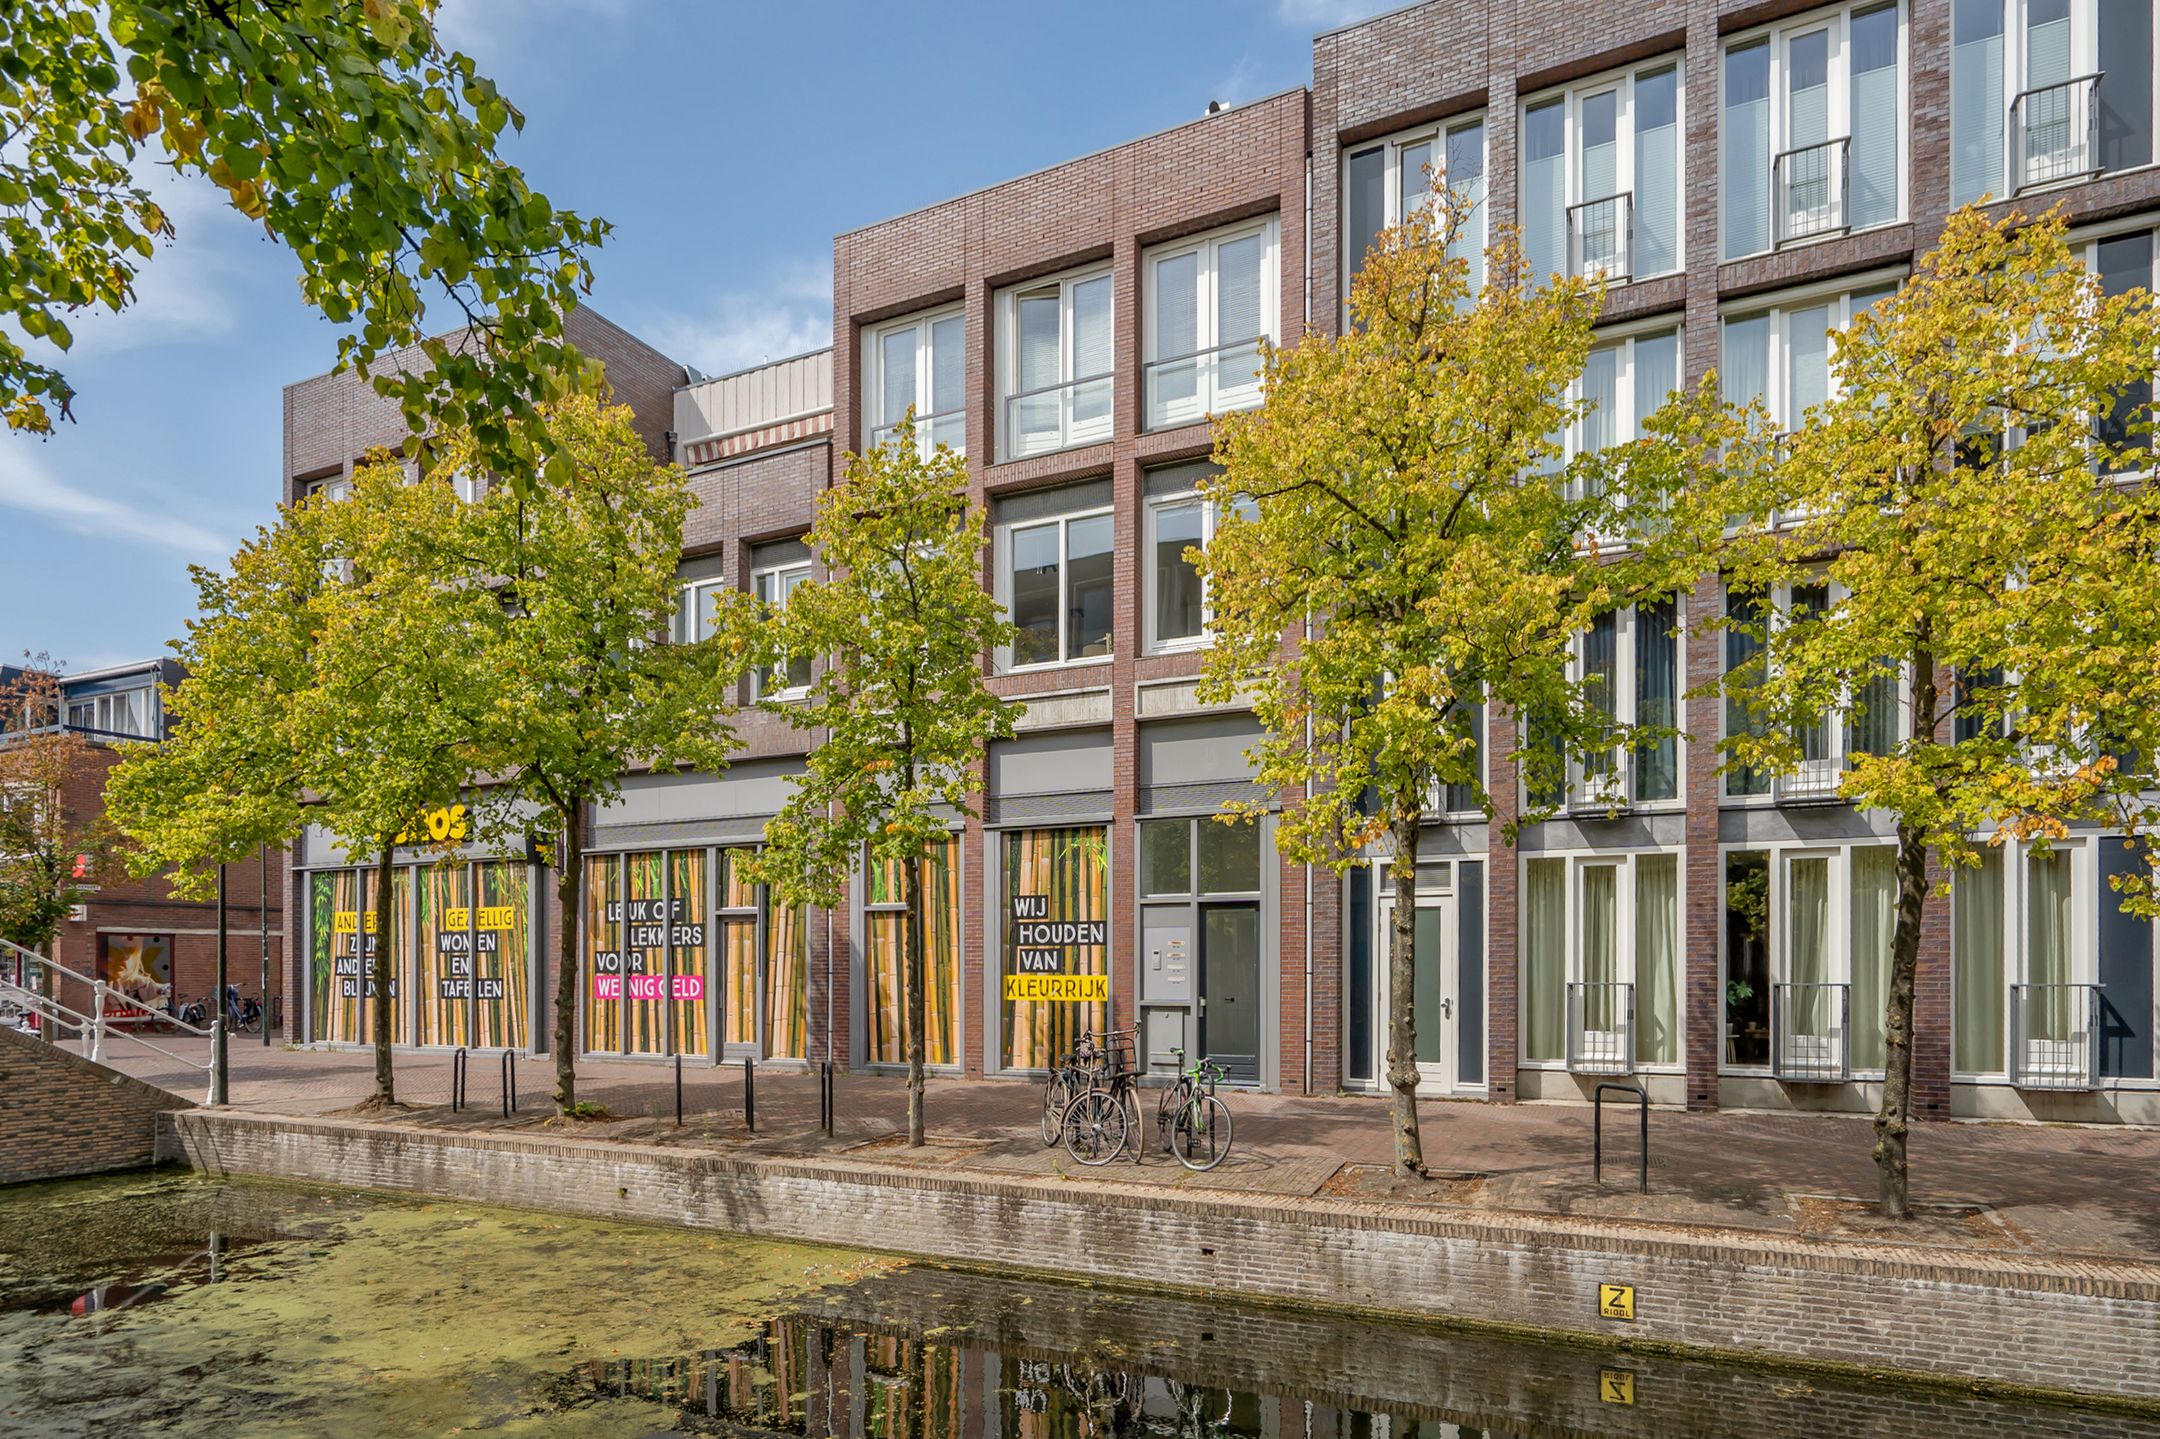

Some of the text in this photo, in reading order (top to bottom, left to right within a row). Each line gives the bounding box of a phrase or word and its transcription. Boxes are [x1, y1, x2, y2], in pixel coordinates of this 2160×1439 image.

[608, 900, 681, 921] LEUK OF
[1014, 897, 1046, 917] WIJ
[440, 933, 496, 951] WONEN
[631, 925, 702, 946] LEKKERS
[1020, 923, 1104, 944] HOUDEN
[349, 936, 376, 952] ZJN
[452, 957, 469, 974] EN
[1021, 951, 1058, 970] VAN
[343, 980, 397, 996] BLJVN
[442, 980, 502, 998] TAFELEN
[598, 978, 655, 997] WENIG
[1006, 979, 1106, 998] KLEURRIJK
[1608, 1287, 1626, 1309] Z
